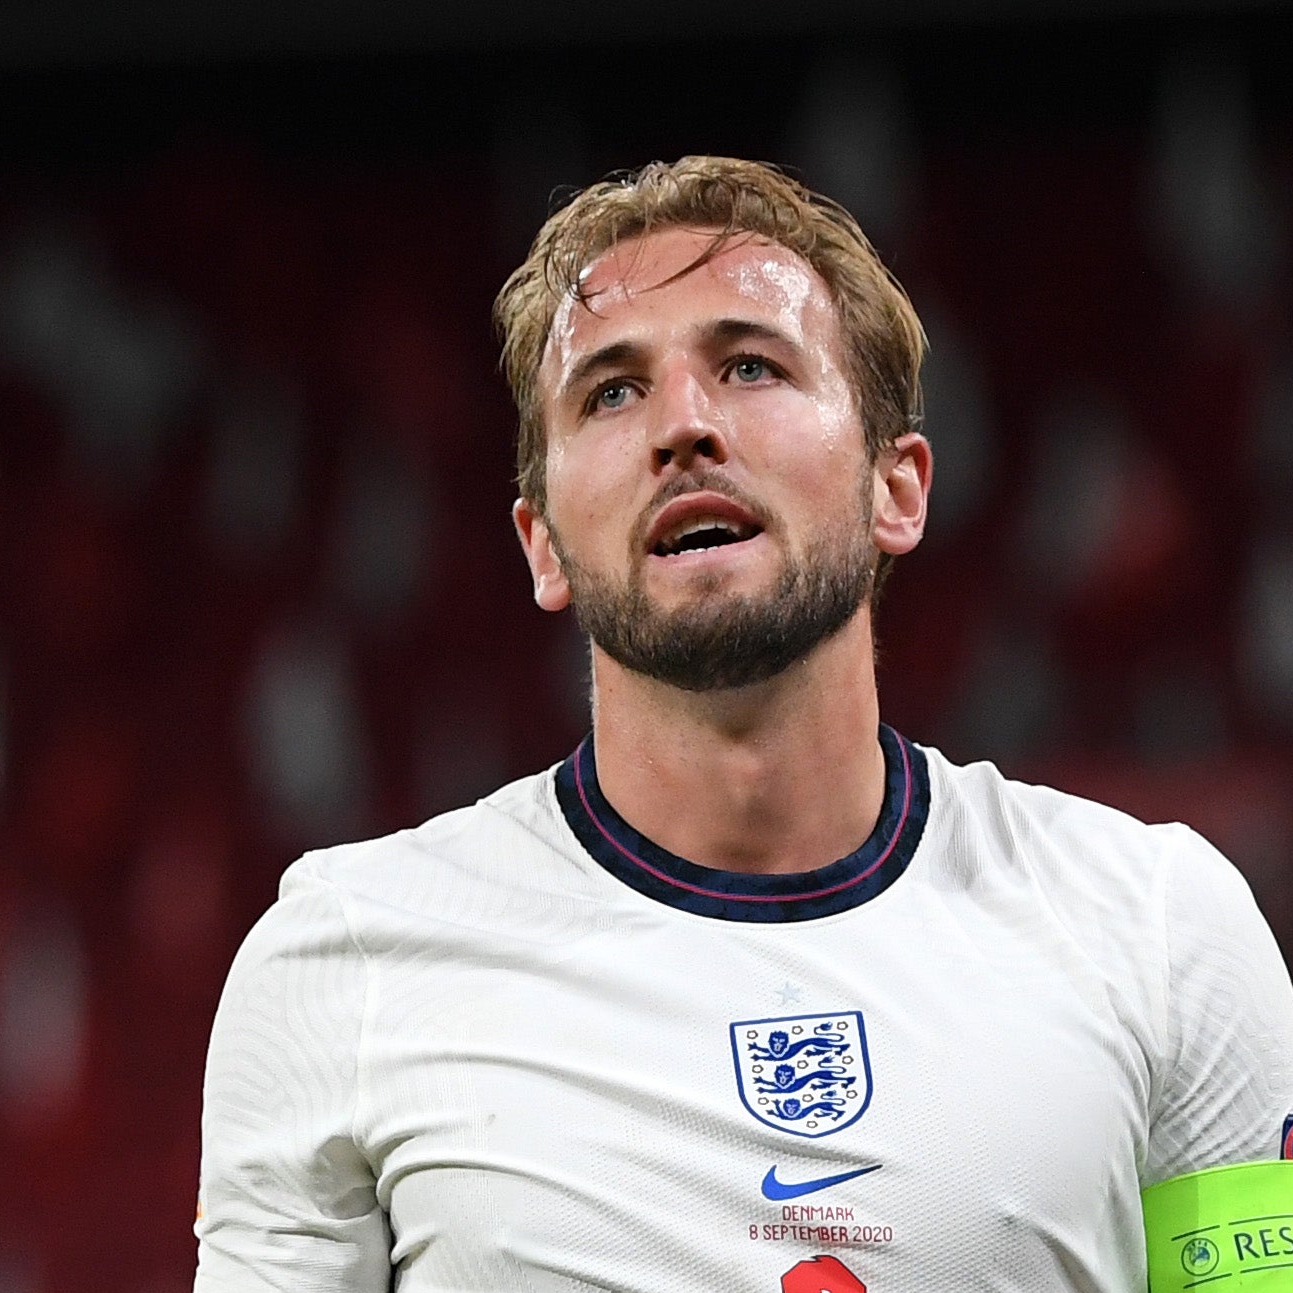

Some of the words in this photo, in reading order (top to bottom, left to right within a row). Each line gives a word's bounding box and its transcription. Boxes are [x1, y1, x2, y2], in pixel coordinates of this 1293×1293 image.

[782, 1205, 855, 1221] DENMARK
[748, 1224, 759, 1241] 8
[762, 1224, 849, 1242] SEPTEMBER
[852, 1225, 893, 1242] 2020
